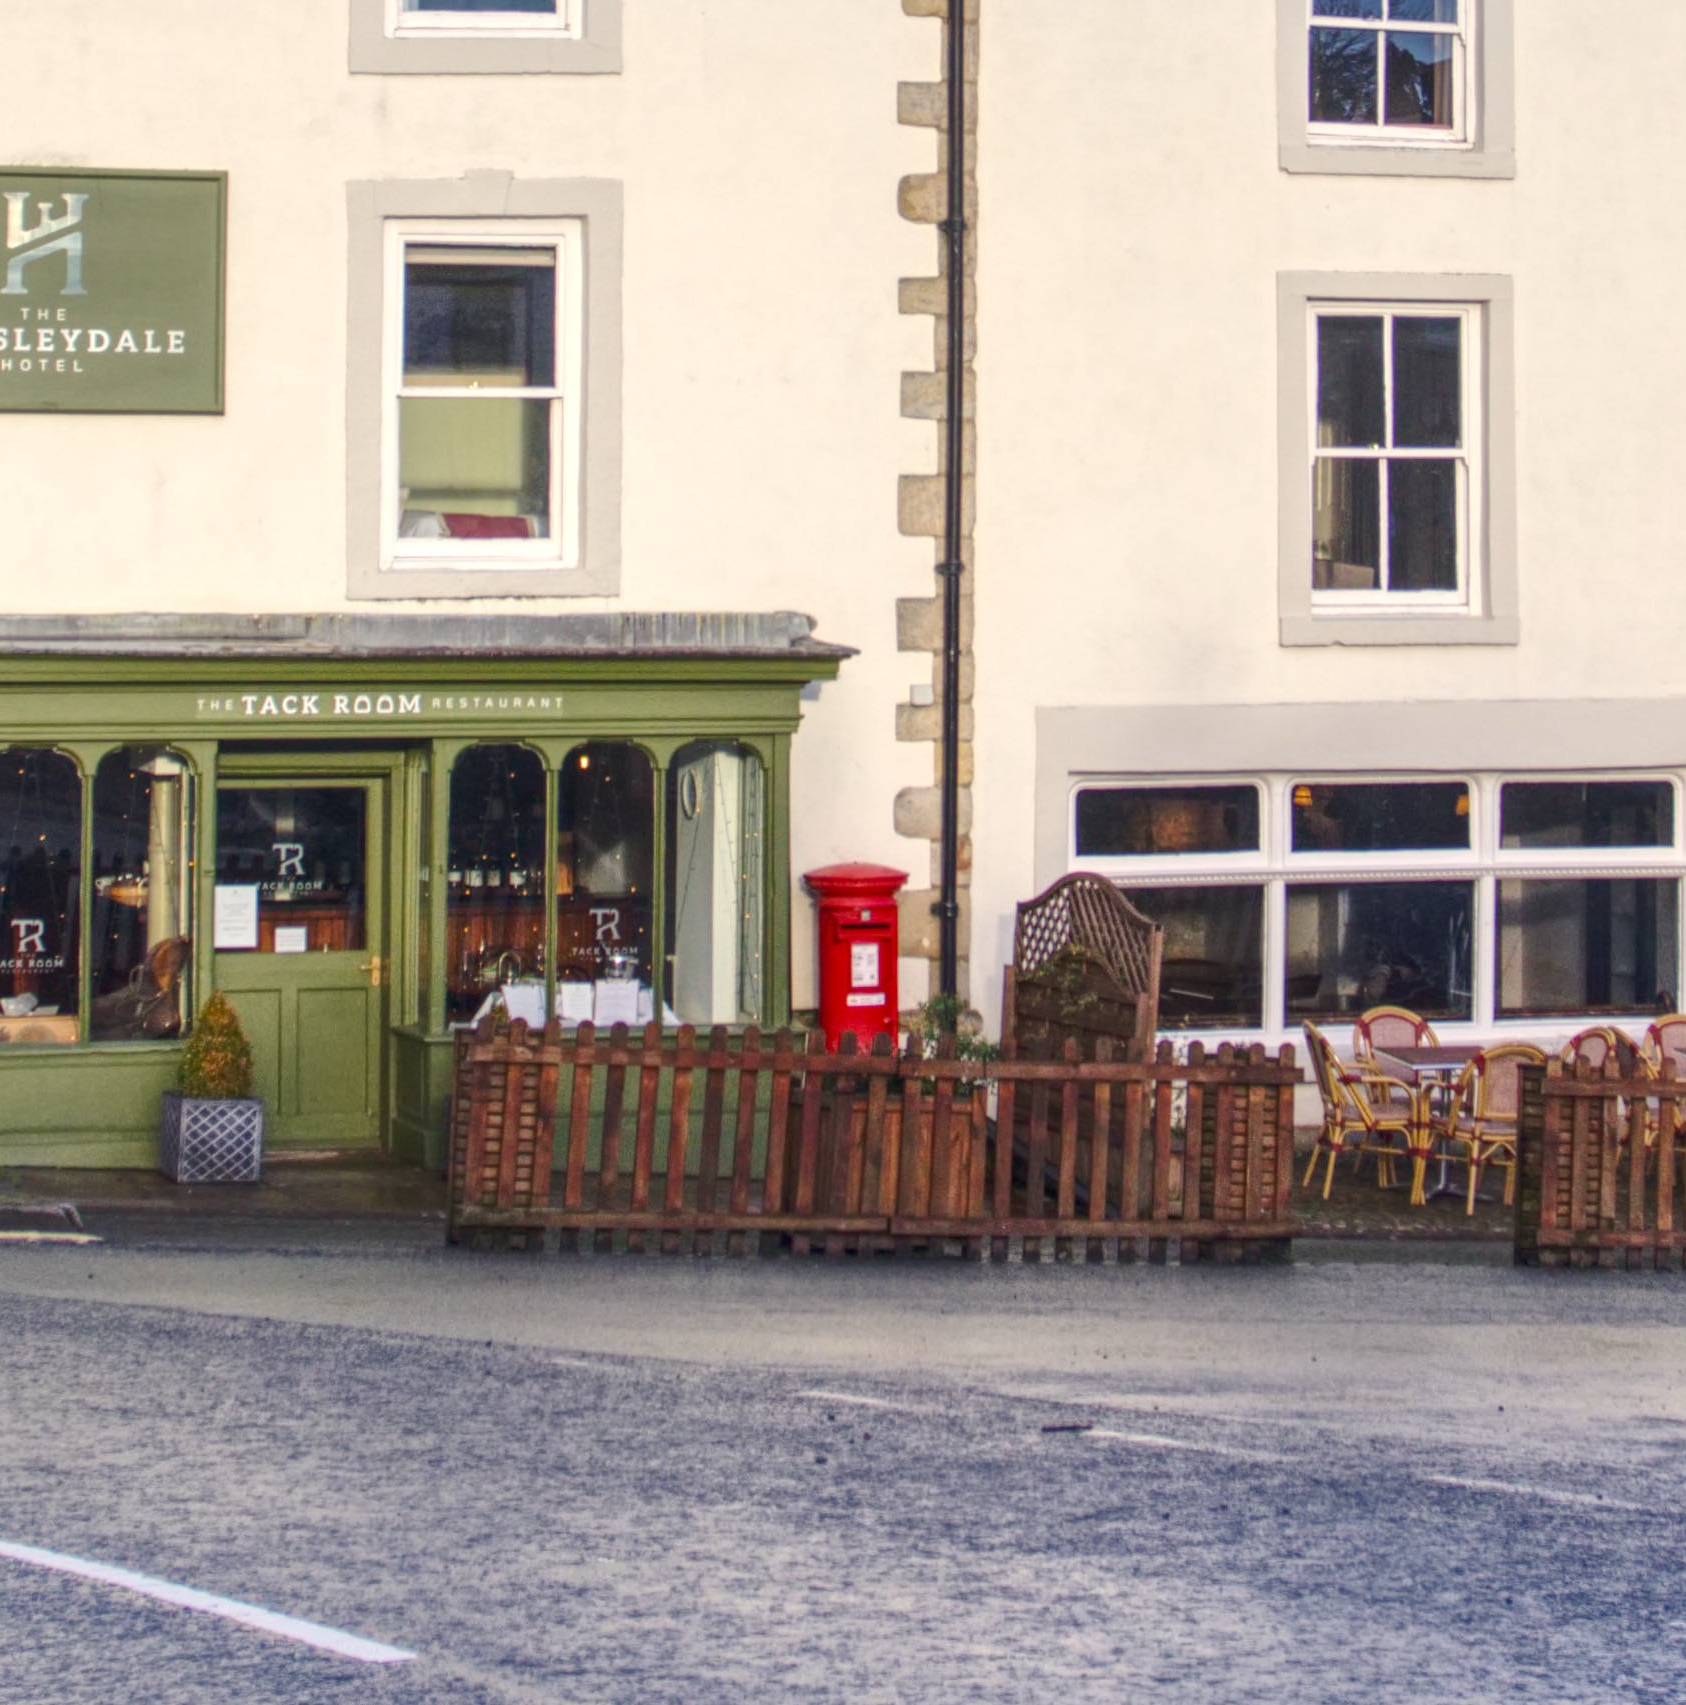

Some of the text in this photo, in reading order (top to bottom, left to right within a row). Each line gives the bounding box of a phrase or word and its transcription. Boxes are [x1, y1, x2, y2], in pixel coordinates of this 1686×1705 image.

[20, 308, 66, 321] THE
[0, 358, 83, 373] HOTEL
[196, 694, 563, 715] THE TACK ROOM RESTAURANT
